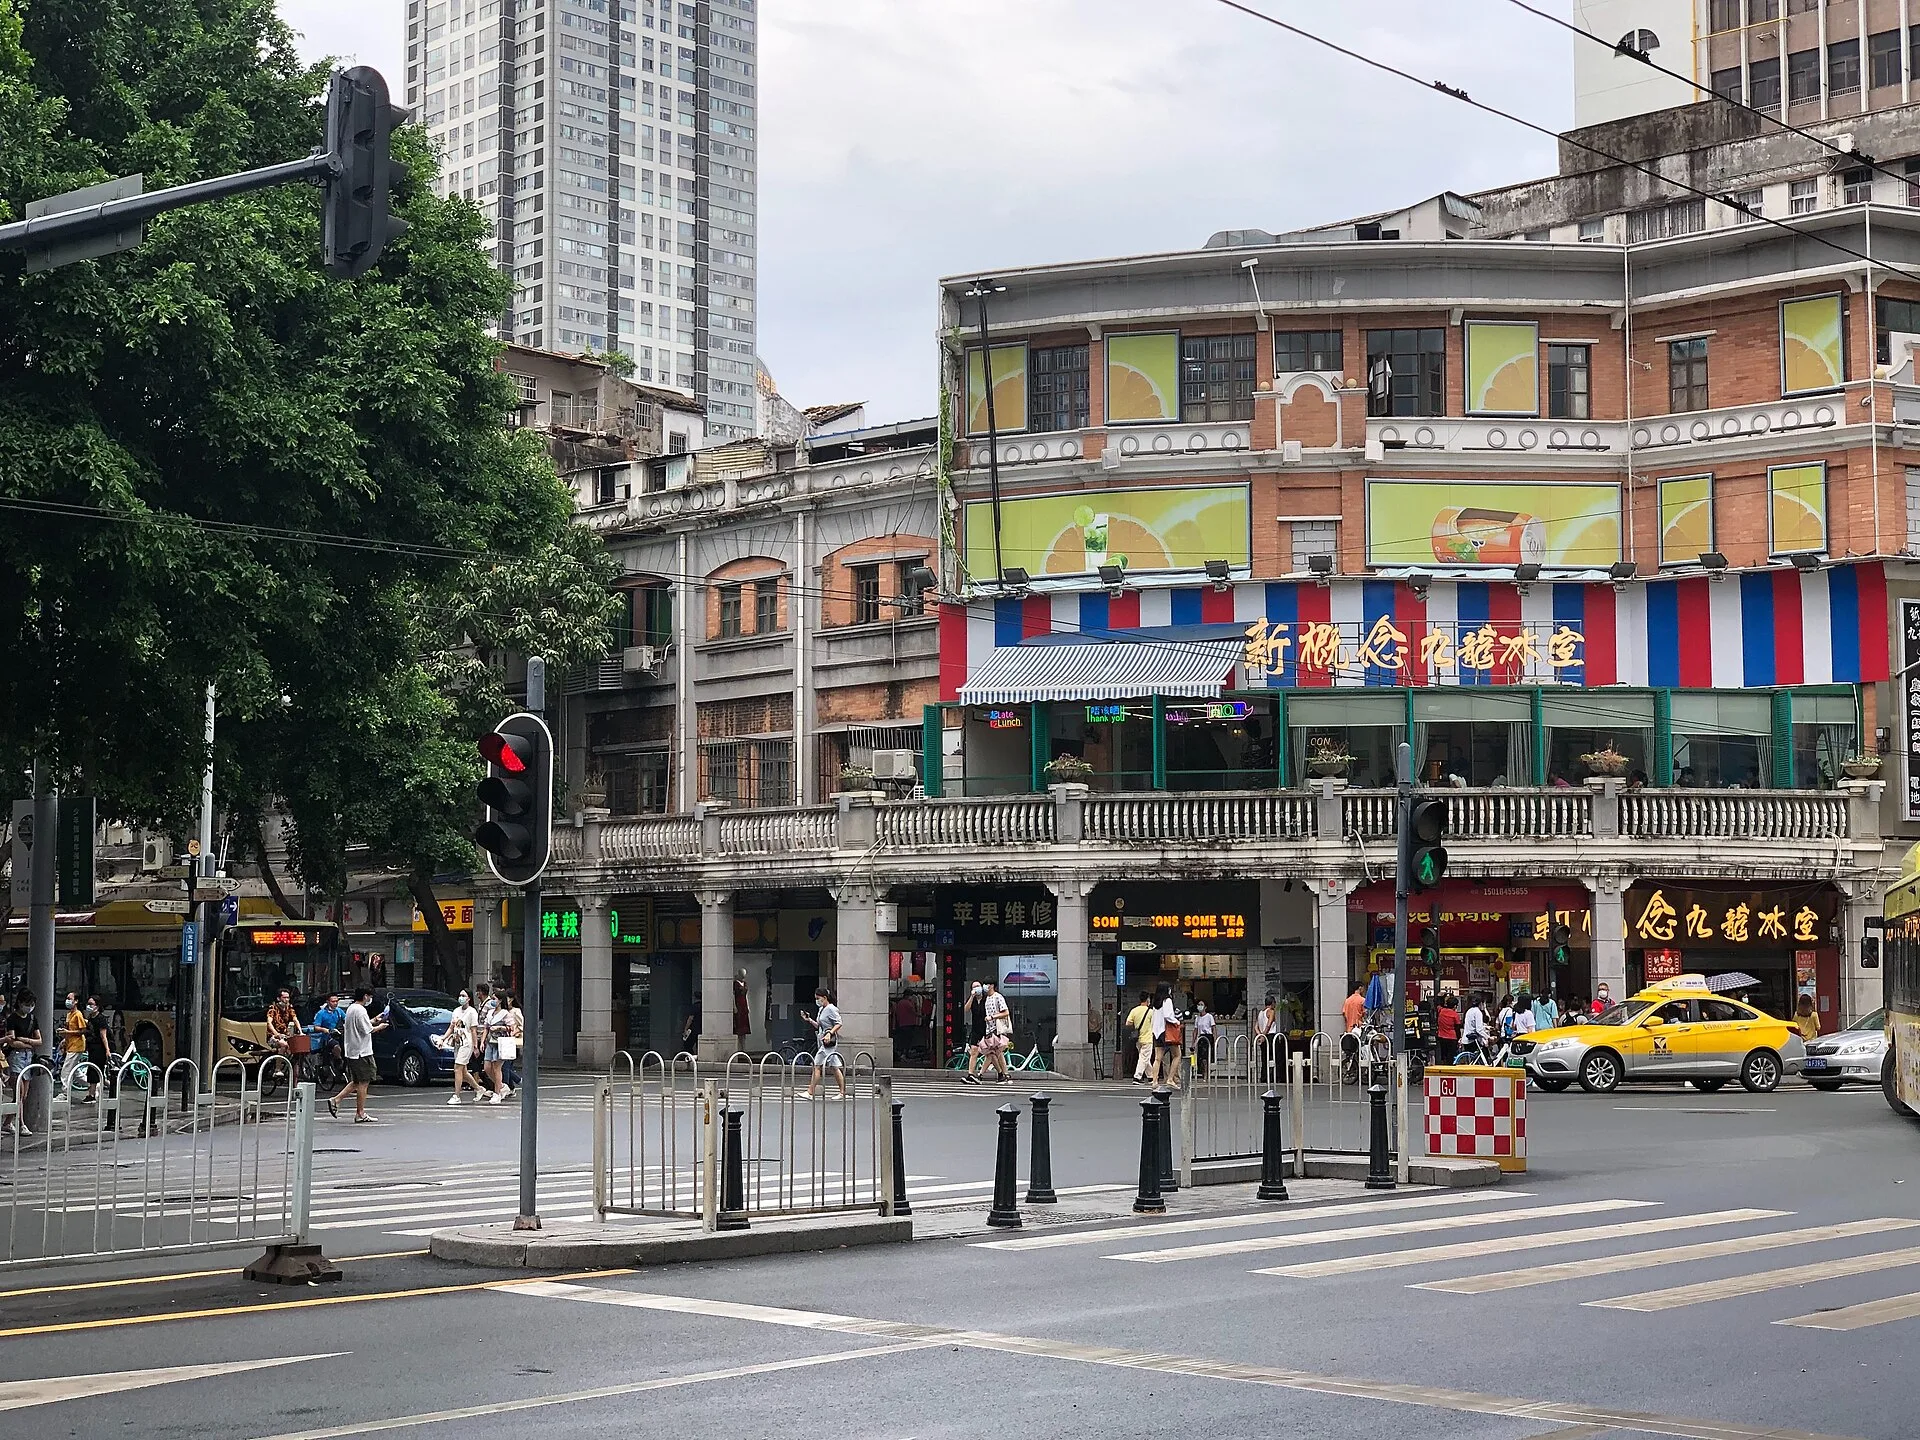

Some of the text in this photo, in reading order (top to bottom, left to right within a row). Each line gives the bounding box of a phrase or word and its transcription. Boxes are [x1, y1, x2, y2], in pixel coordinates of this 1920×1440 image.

[1243, 614, 1586, 675] 新概念九龍冰室
[998, 710, 1014, 719] Late
[952, 901, 1053, 926] 苹果维修
[1092, 916, 1119, 928] SOM
[1184, 915, 1217, 927] SOME
[1221, 914, 1245, 927] TEA
[1441, 1079, 1455, 1096] GJ
